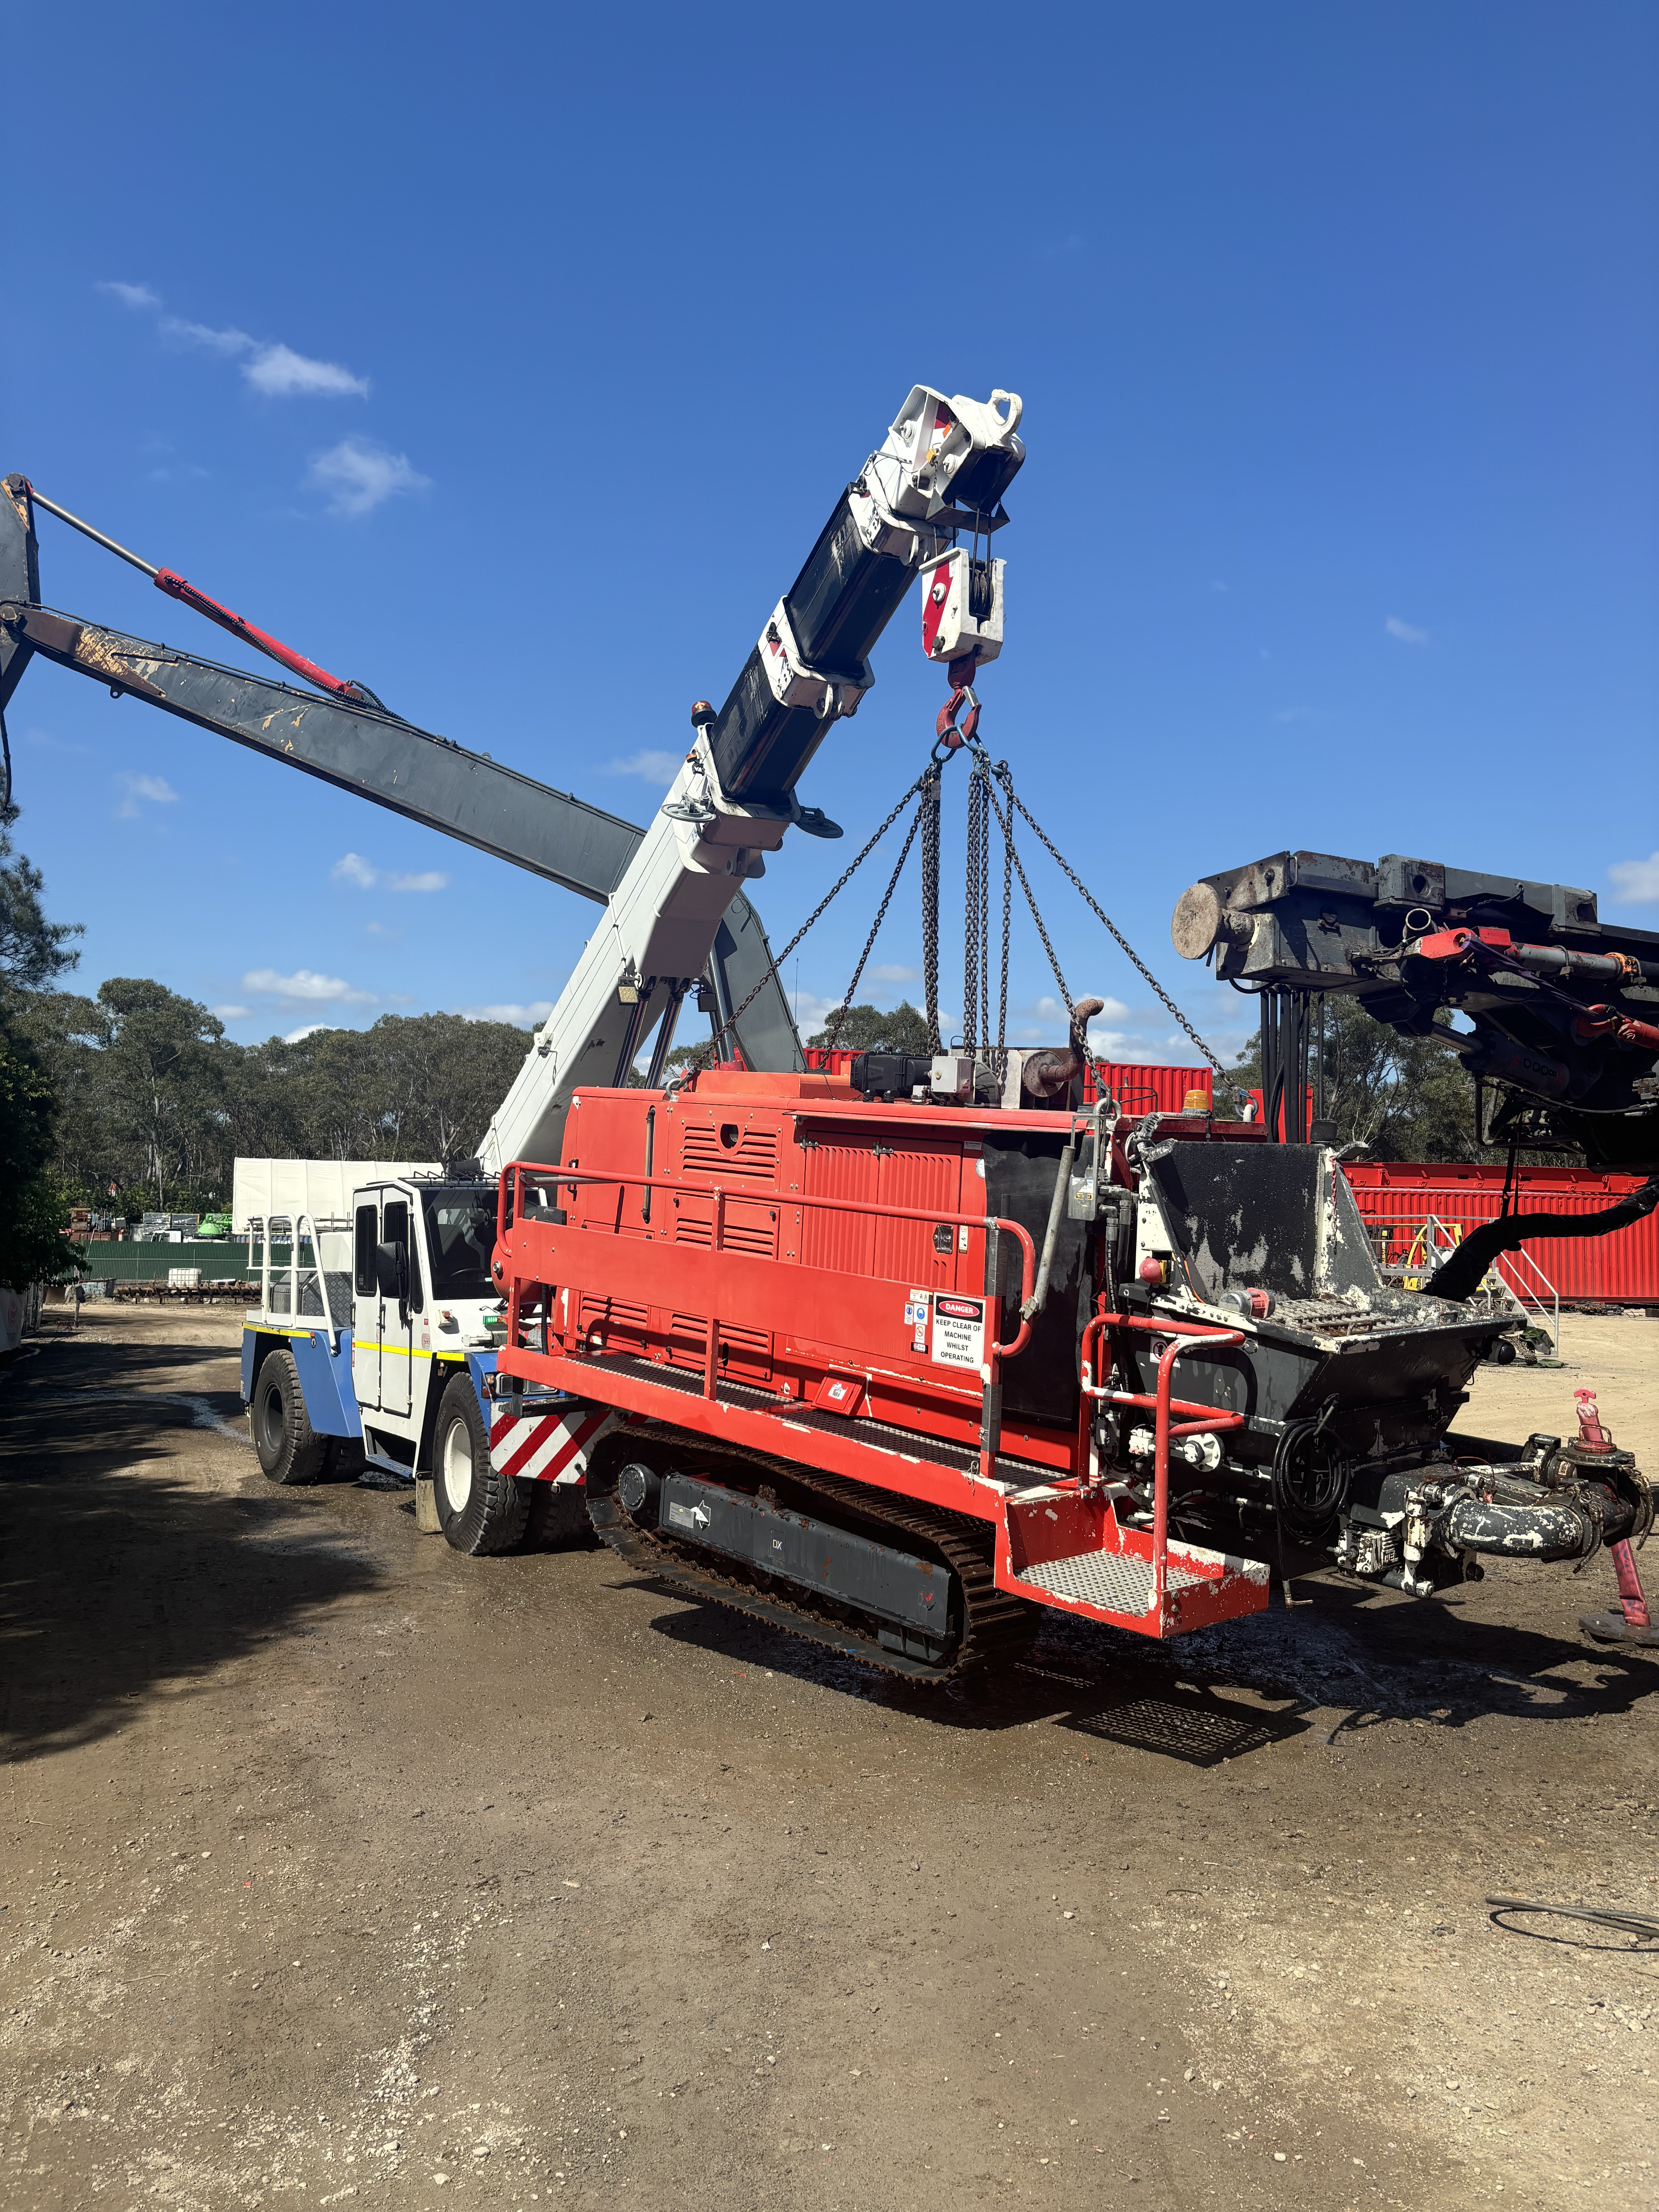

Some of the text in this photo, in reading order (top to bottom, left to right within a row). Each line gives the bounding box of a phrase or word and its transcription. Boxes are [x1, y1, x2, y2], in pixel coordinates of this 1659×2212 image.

[945, 1303, 974, 1314] DANGER
[936, 1319, 951, 1327] KEEP
[953, 1322, 971, 1330] CLEAR
[945, 1331, 972, 1341] MACHINE
[947, 1342, 969, 1351] WHILST
[941, 1352, 974, 1363] OPERATING
[773, 1539, 782, 1550] DX
